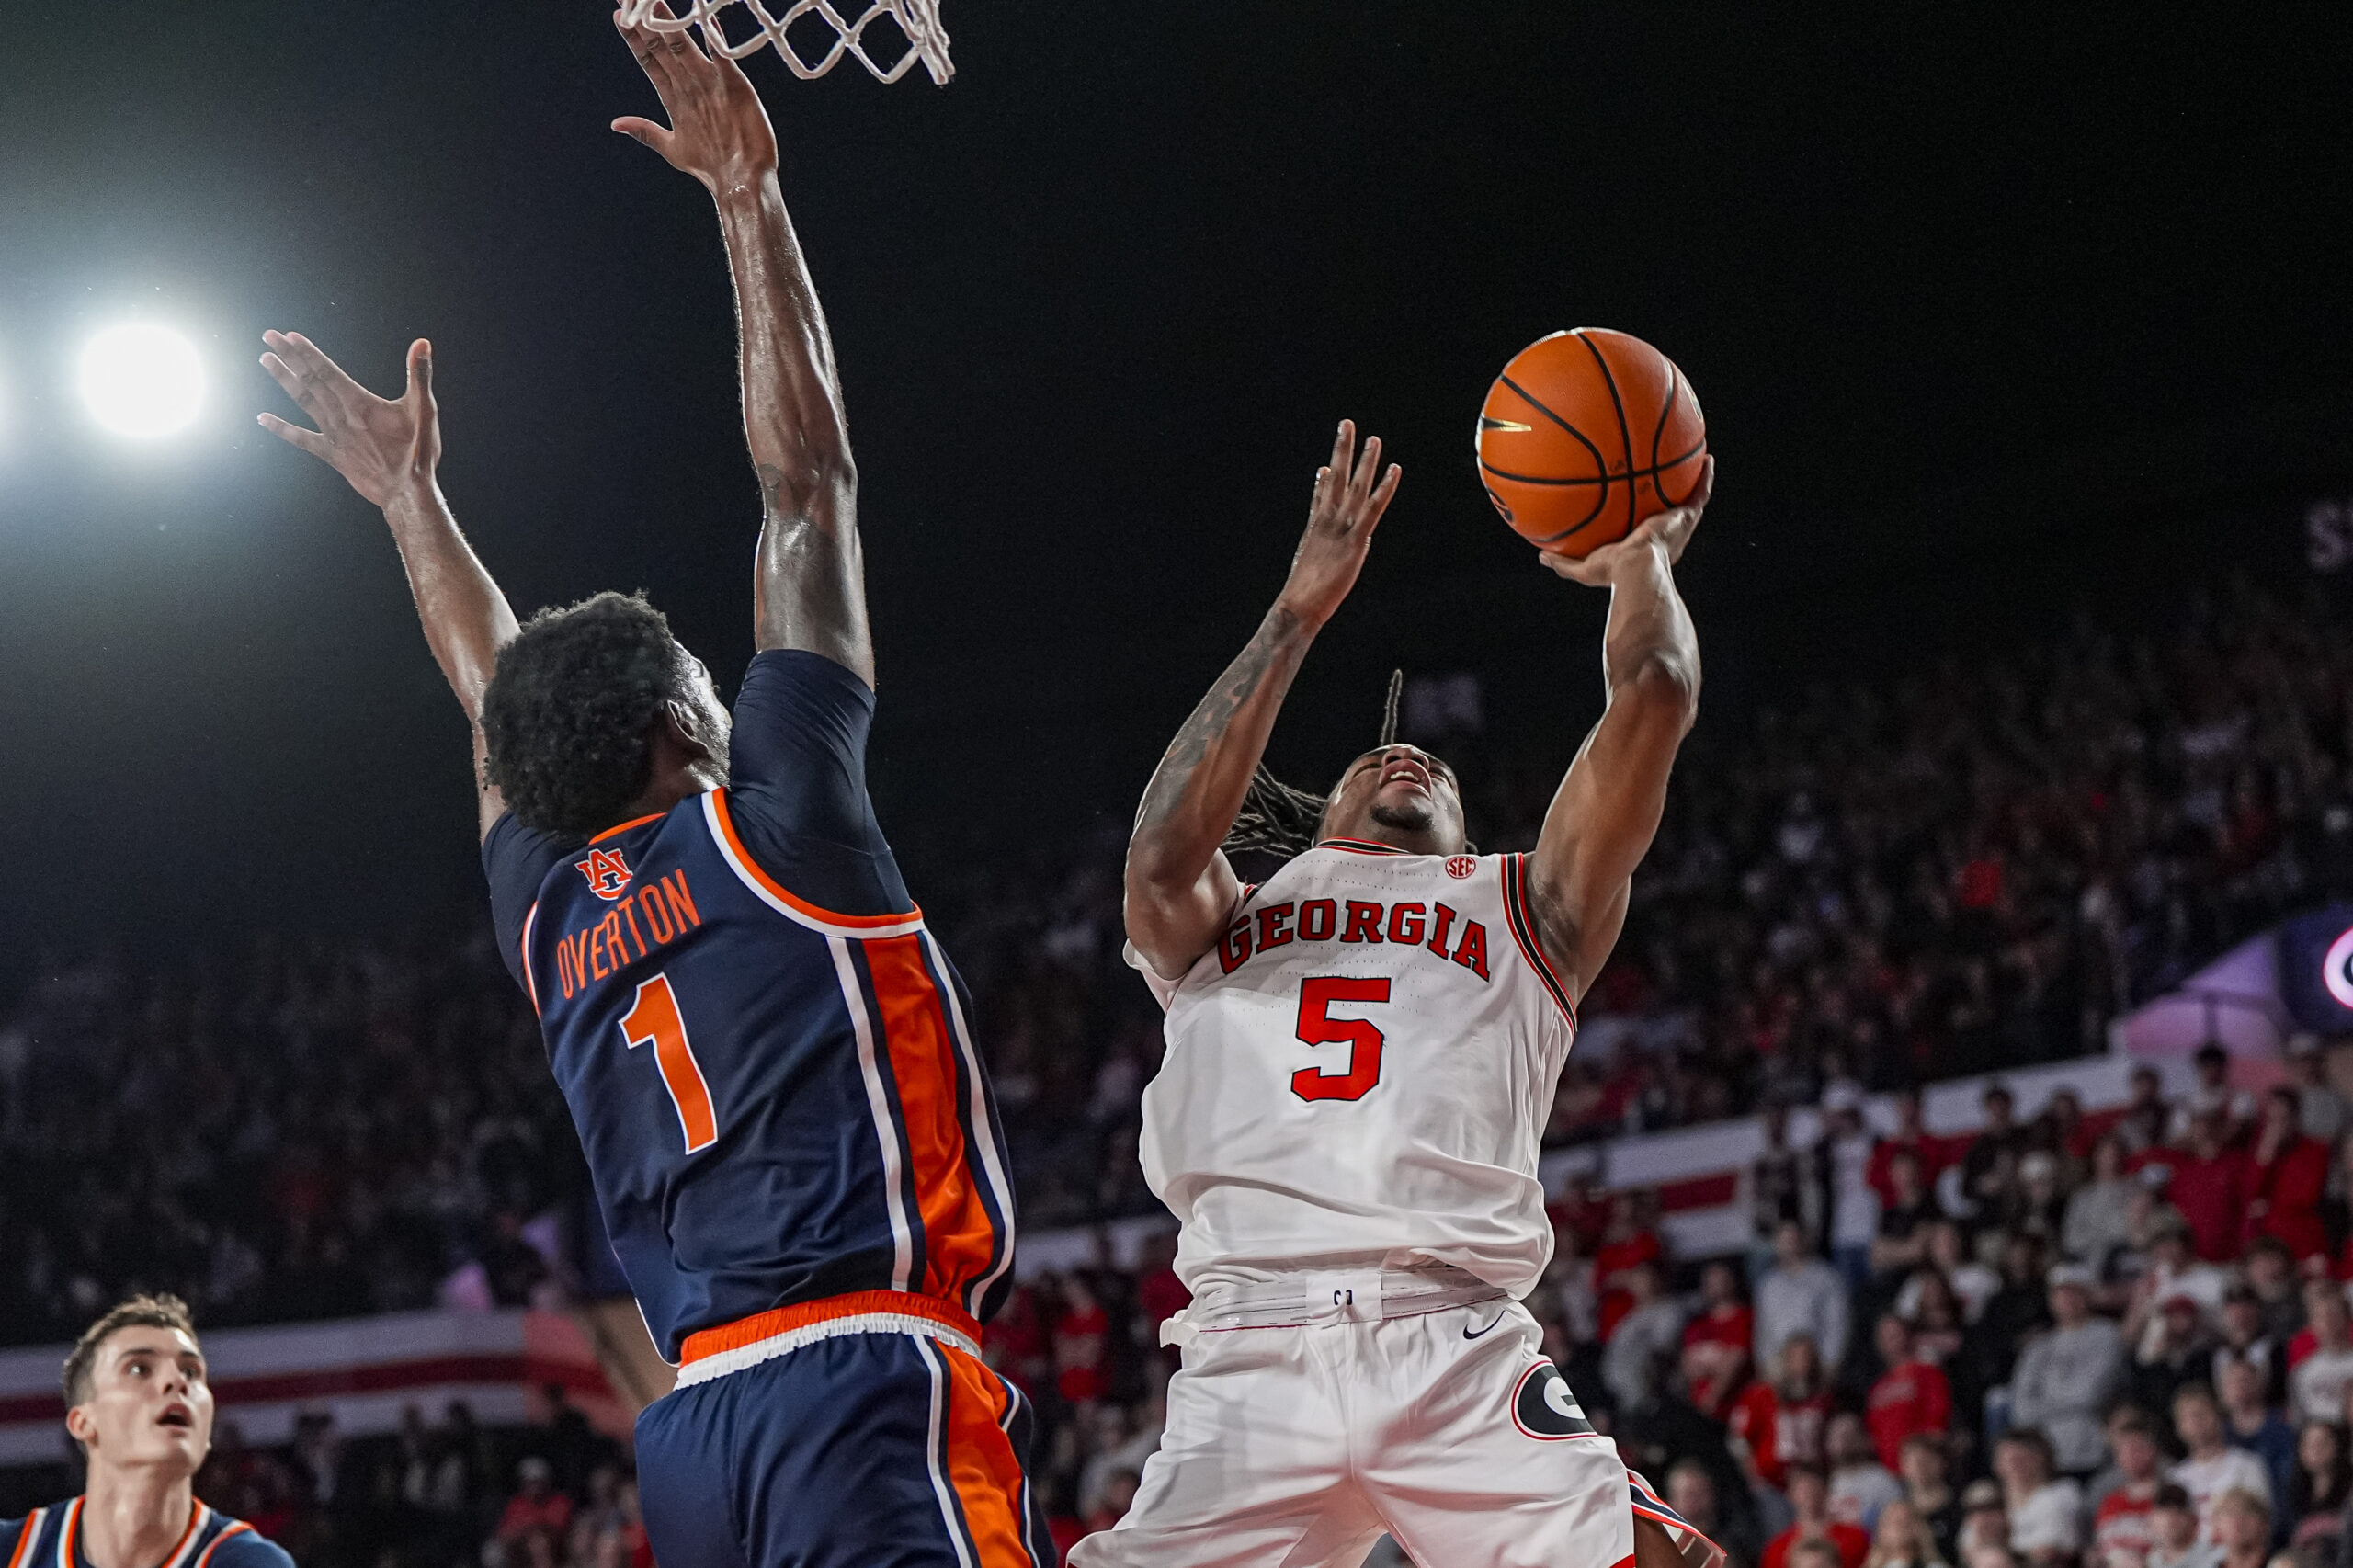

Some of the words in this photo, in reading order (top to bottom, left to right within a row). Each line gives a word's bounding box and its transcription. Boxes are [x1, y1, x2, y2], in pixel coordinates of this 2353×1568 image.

[1448, 857, 1473, 877] SEC
[557, 869, 701, 1000] OVERTON
[1217, 898, 1491, 983] GEORGIA
[618, 971, 718, 1156] 1
[1290, 976, 1392, 1103] 5
